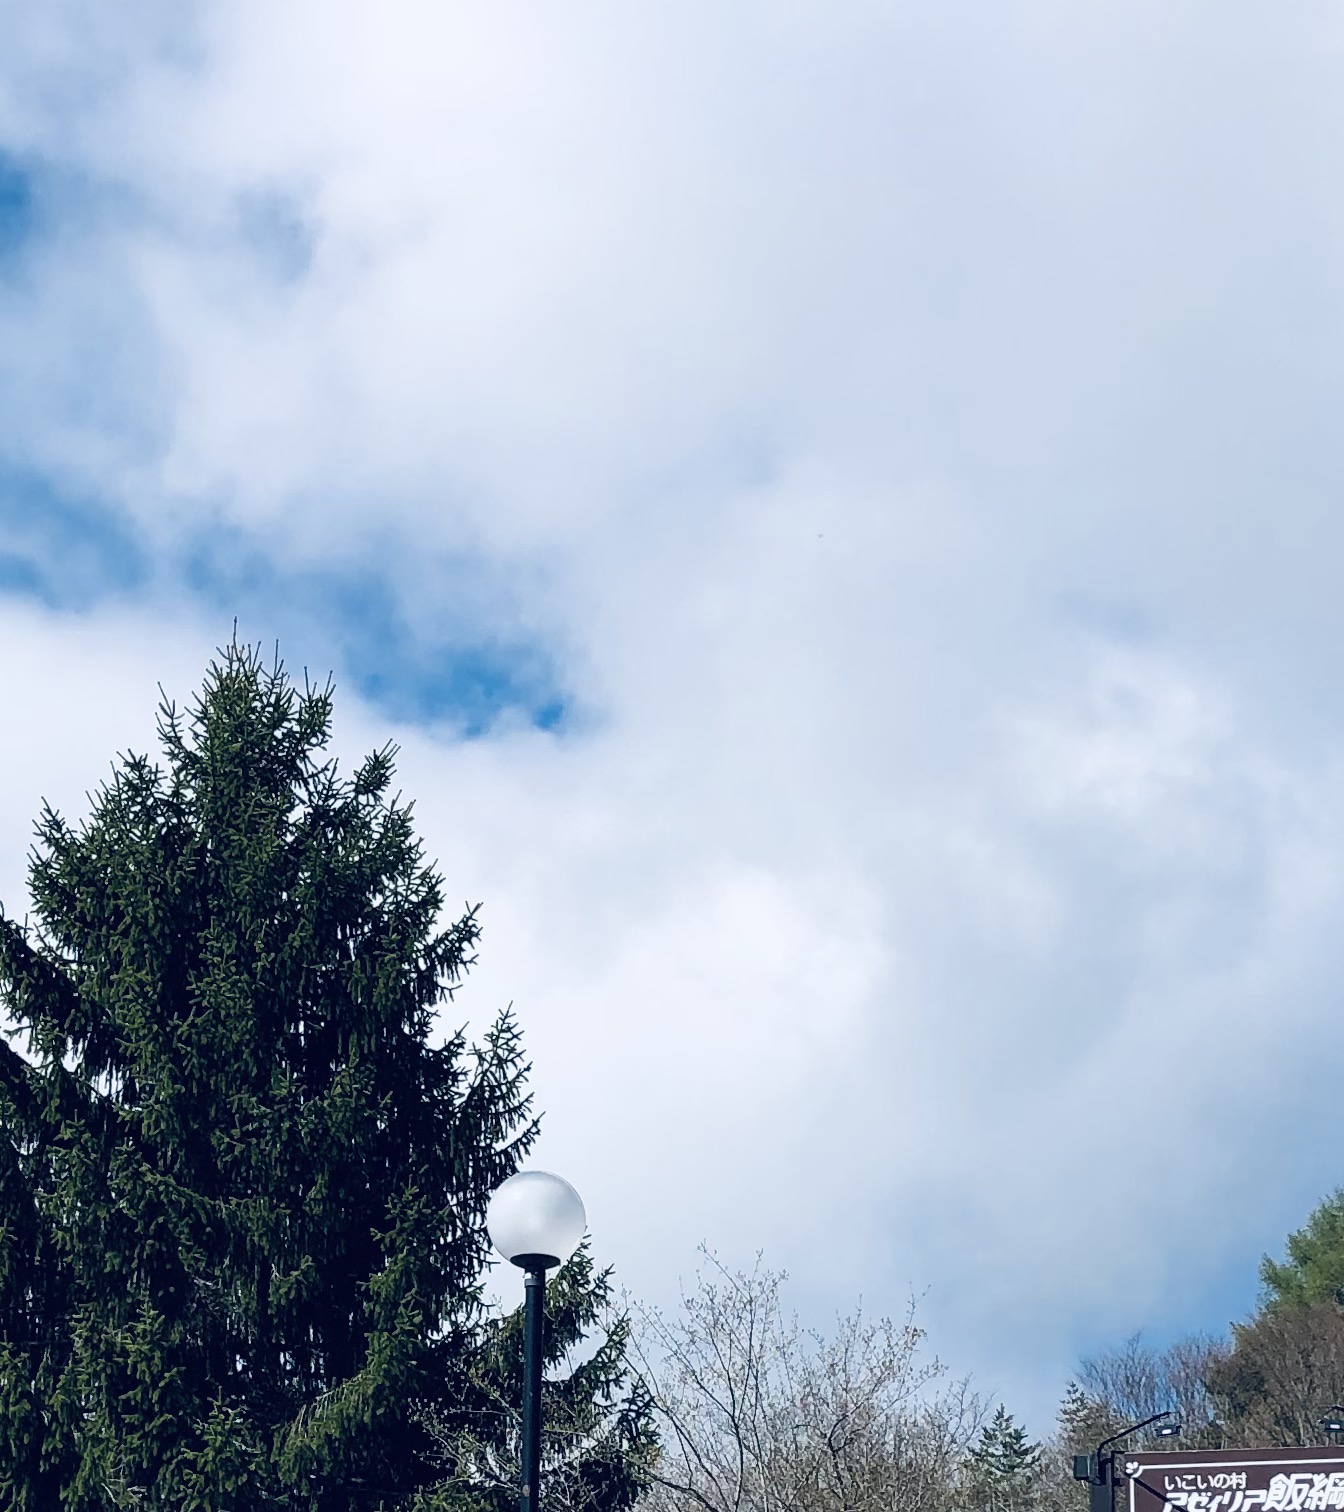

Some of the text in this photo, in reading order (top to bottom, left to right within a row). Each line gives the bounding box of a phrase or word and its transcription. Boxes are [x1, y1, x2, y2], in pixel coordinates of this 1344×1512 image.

[1164, 1471, 1247, 1490] いこいの村
